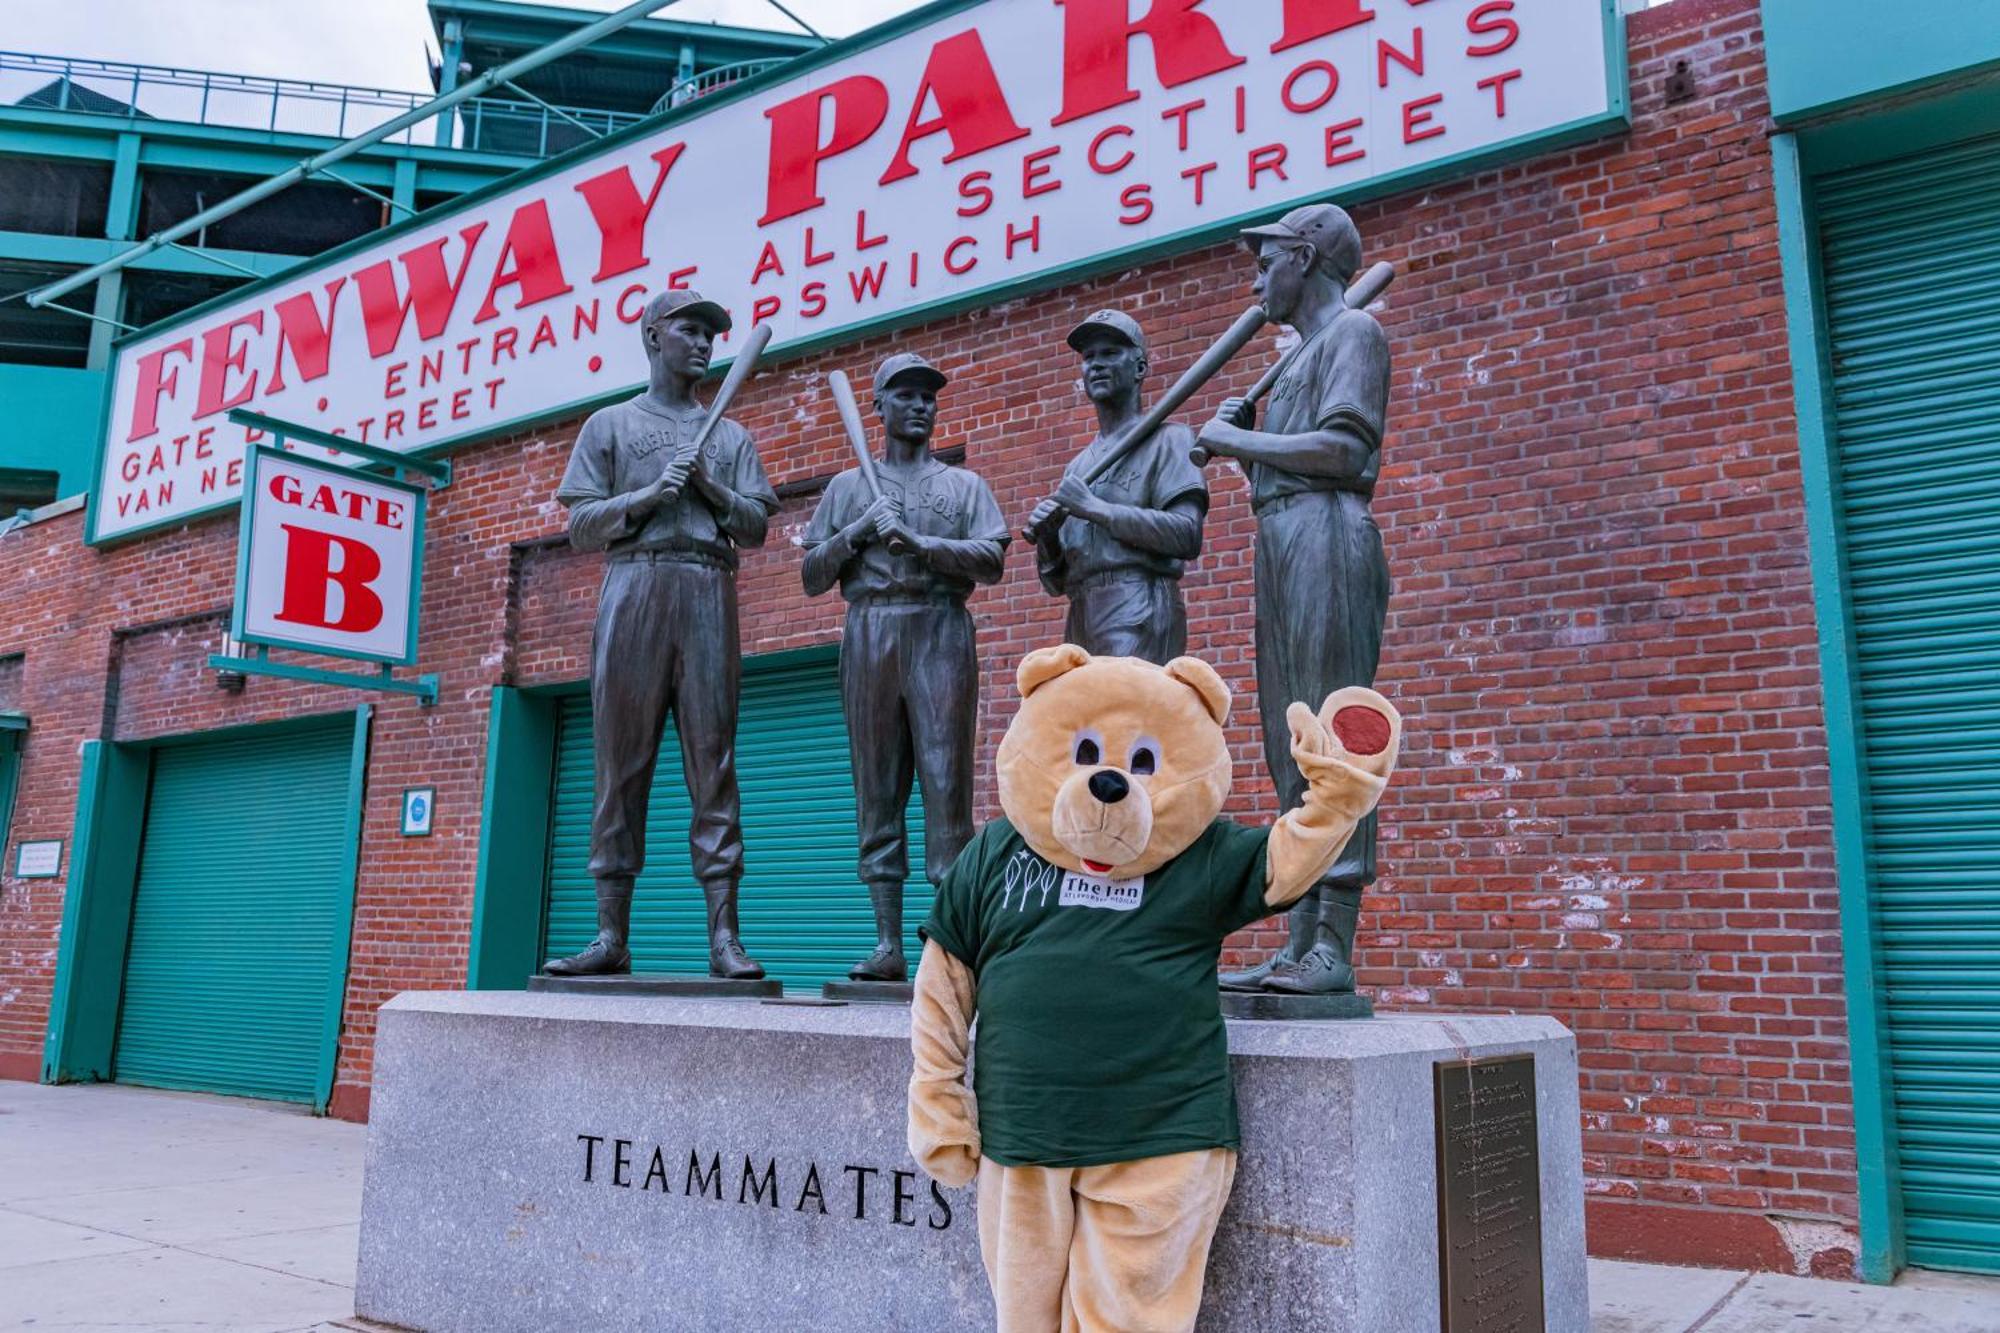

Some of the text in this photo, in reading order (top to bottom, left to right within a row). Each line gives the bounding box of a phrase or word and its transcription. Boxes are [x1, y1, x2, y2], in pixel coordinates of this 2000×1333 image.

[117, 481, 173, 517] VAN
[1118, 68, 1523, 225] STREET
[122, 428, 214, 482] GATE
[384, 265, 699, 399] ENTRANCE
[750, 209, 889, 286] ALL
[957, 0, 1520, 217] SECTIONS
[127, 142, 686, 441] FENWAY
[268, 473, 405, 530] GATE
[273, 523, 384, 633] B
[1066, 877, 1102, 895] The
[577, 1134, 953, 1231] TEAMMATES
